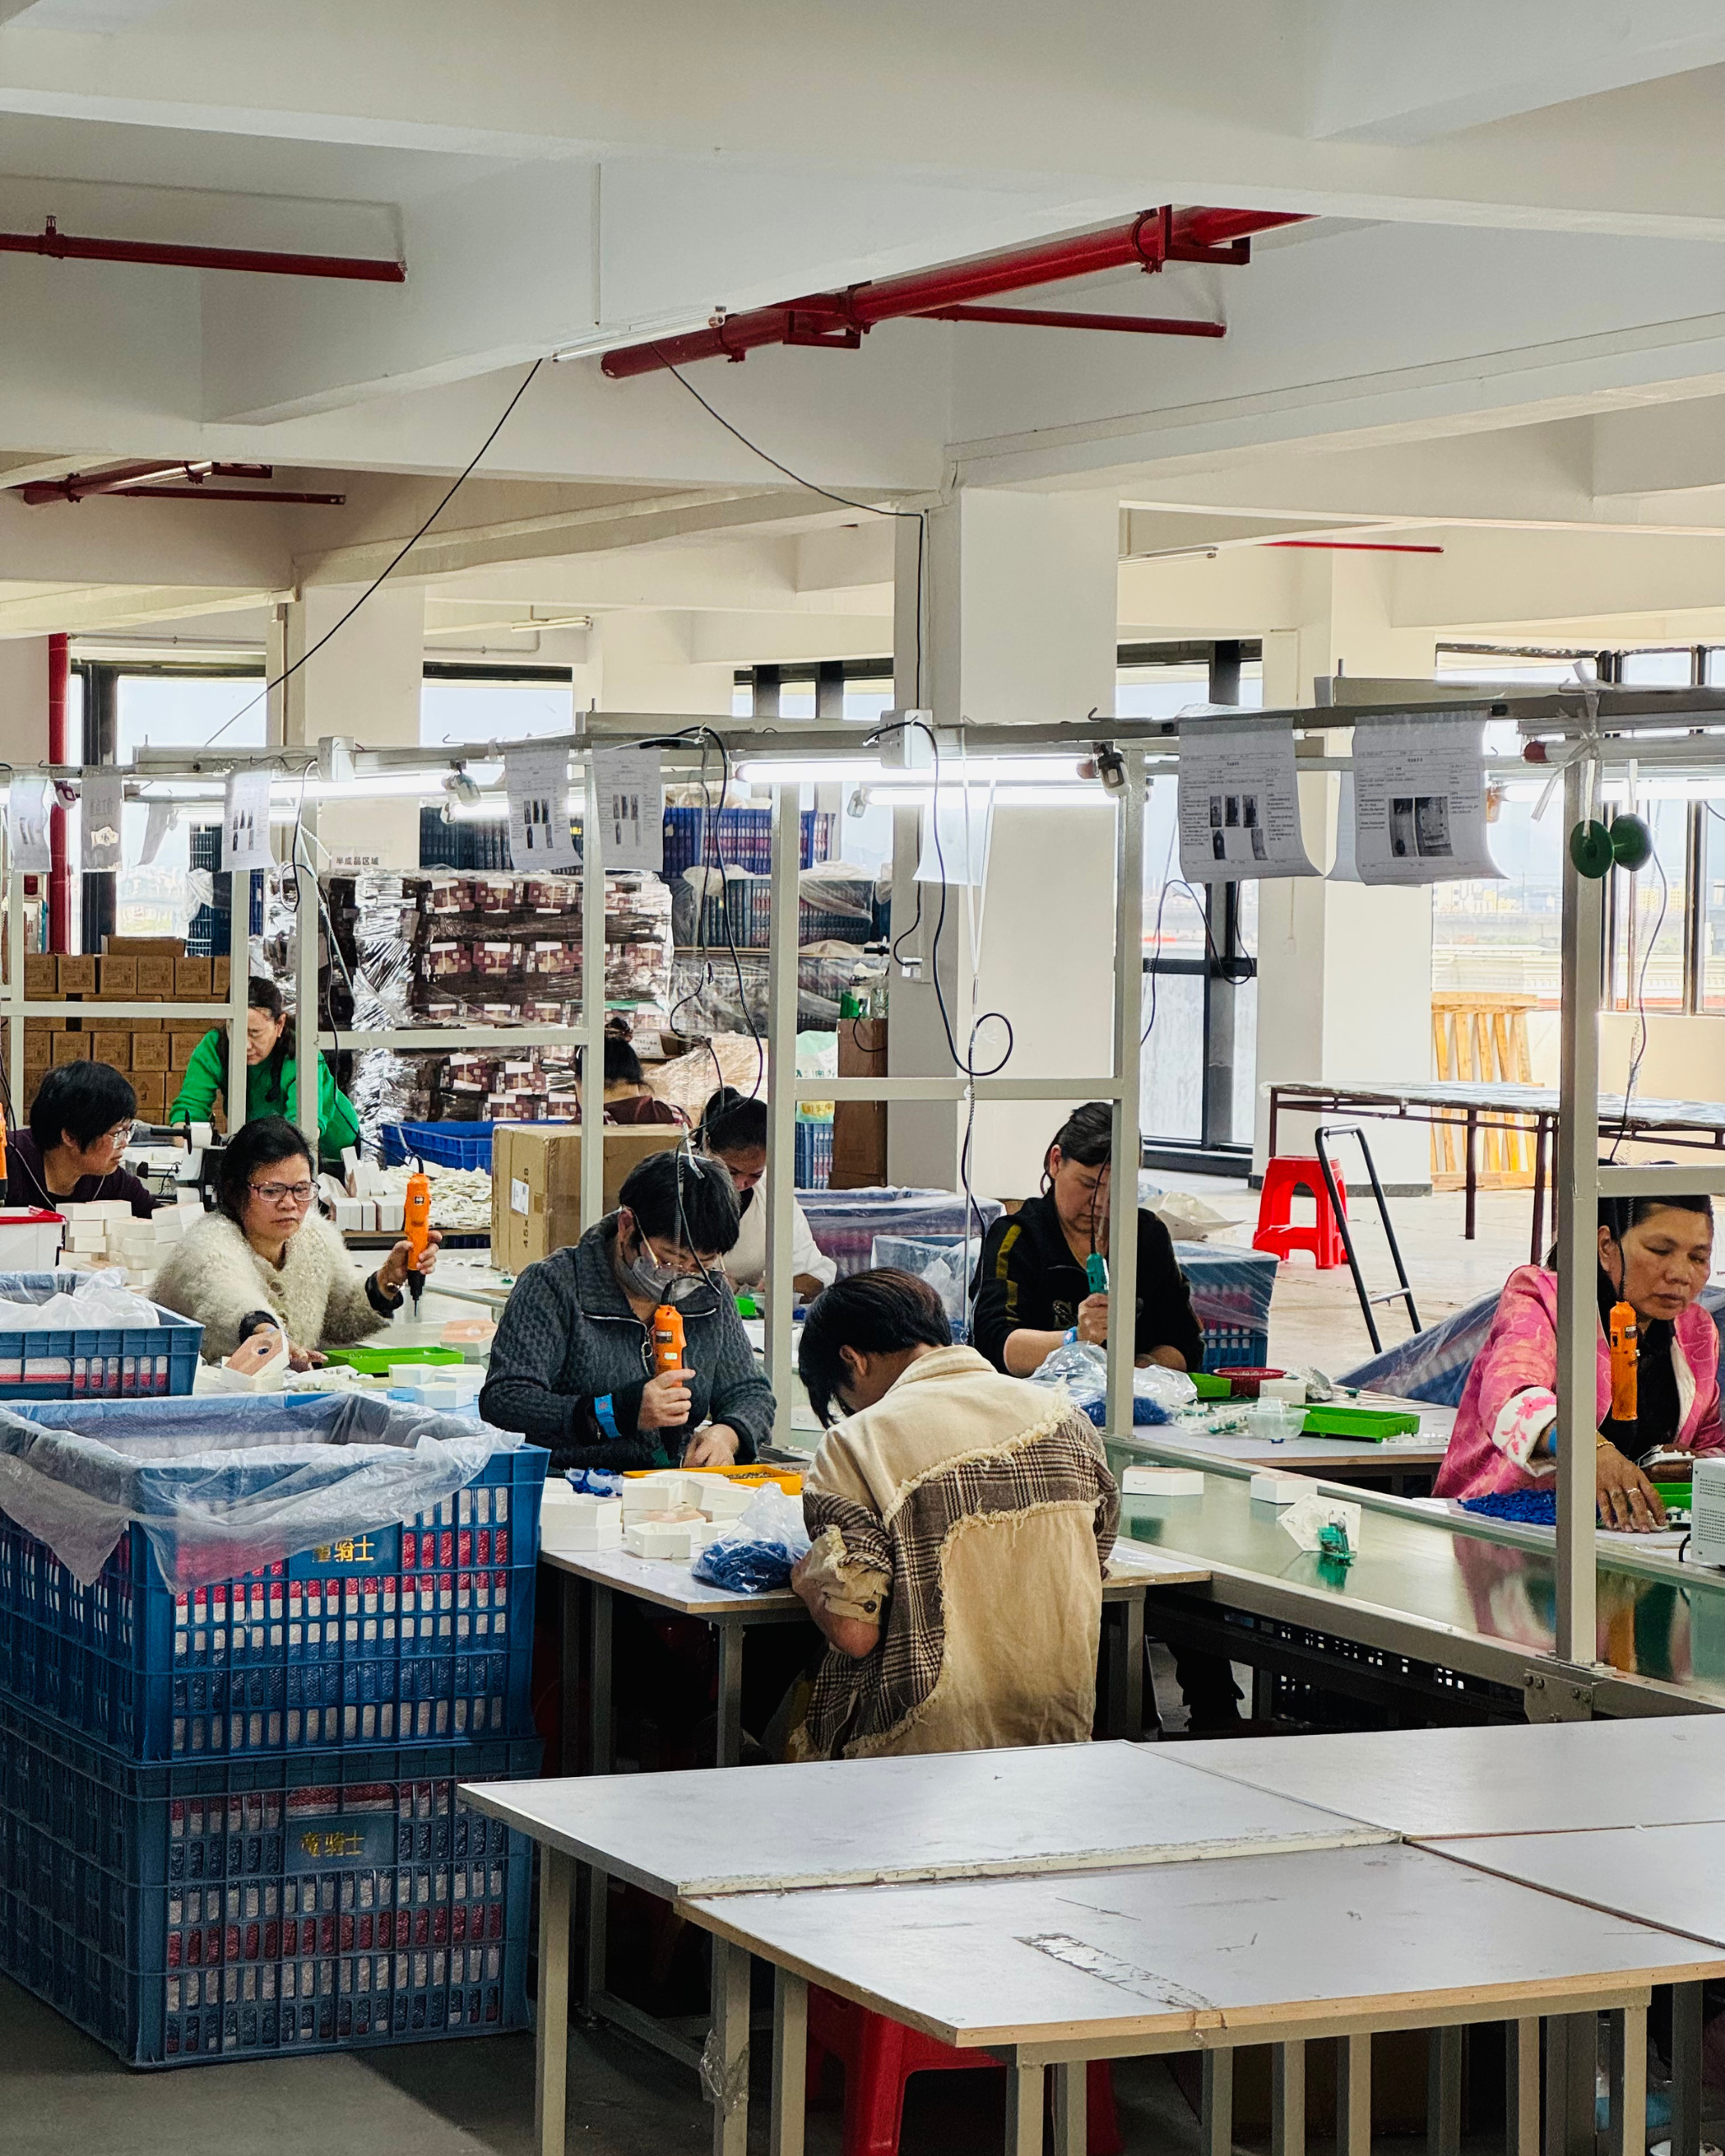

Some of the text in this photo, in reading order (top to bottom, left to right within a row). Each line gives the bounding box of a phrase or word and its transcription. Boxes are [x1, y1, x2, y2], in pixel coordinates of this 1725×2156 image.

[336, 857, 379, 866] 半成品区域
